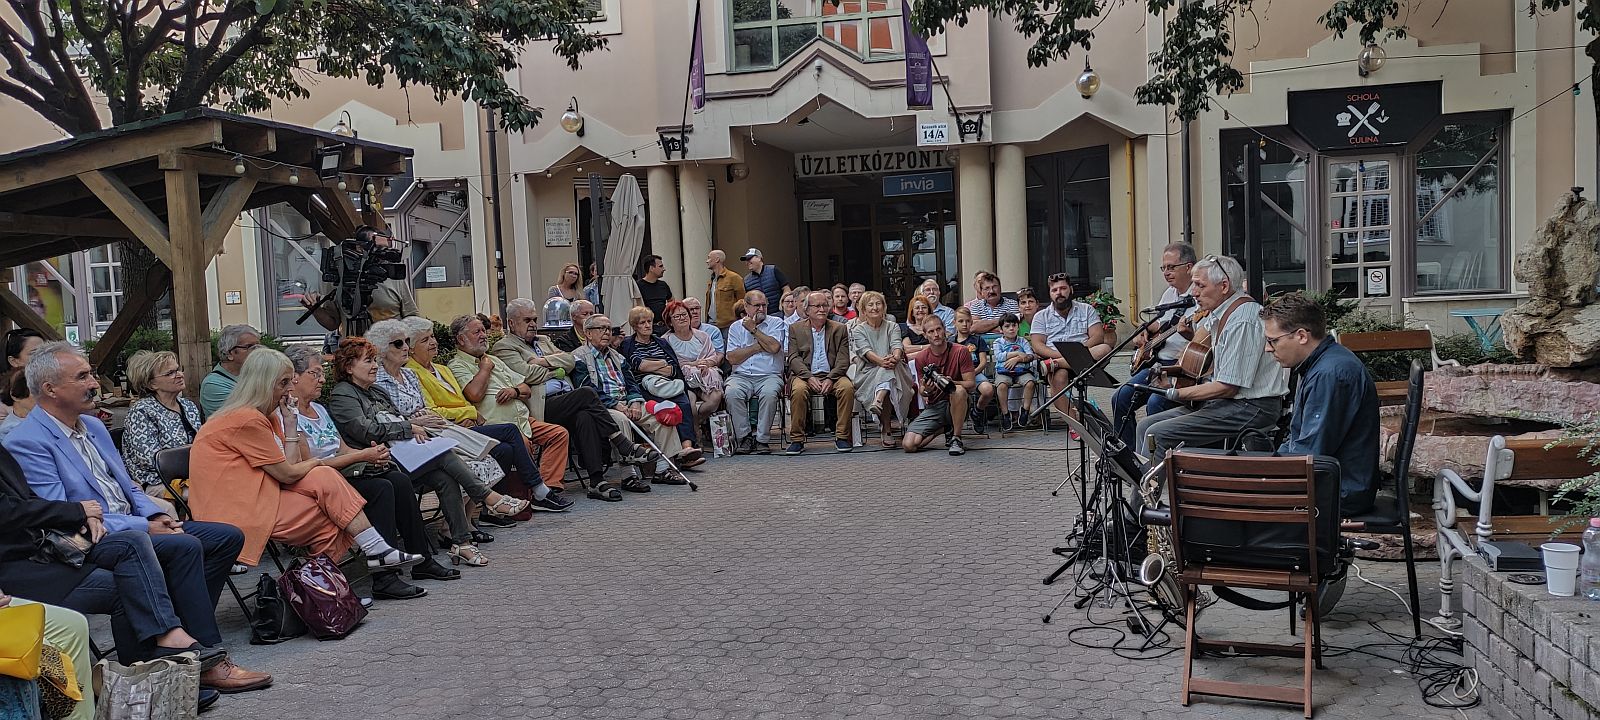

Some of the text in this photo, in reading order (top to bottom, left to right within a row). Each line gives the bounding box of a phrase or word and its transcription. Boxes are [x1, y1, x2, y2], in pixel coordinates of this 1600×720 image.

[1347, 93, 1380, 101] SCHOLA
[923, 129, 944, 140] 14/A
[1349, 136, 1379, 144] CULINA
[668, 141, 680, 150] 19
[900, 177, 935, 191] invia
